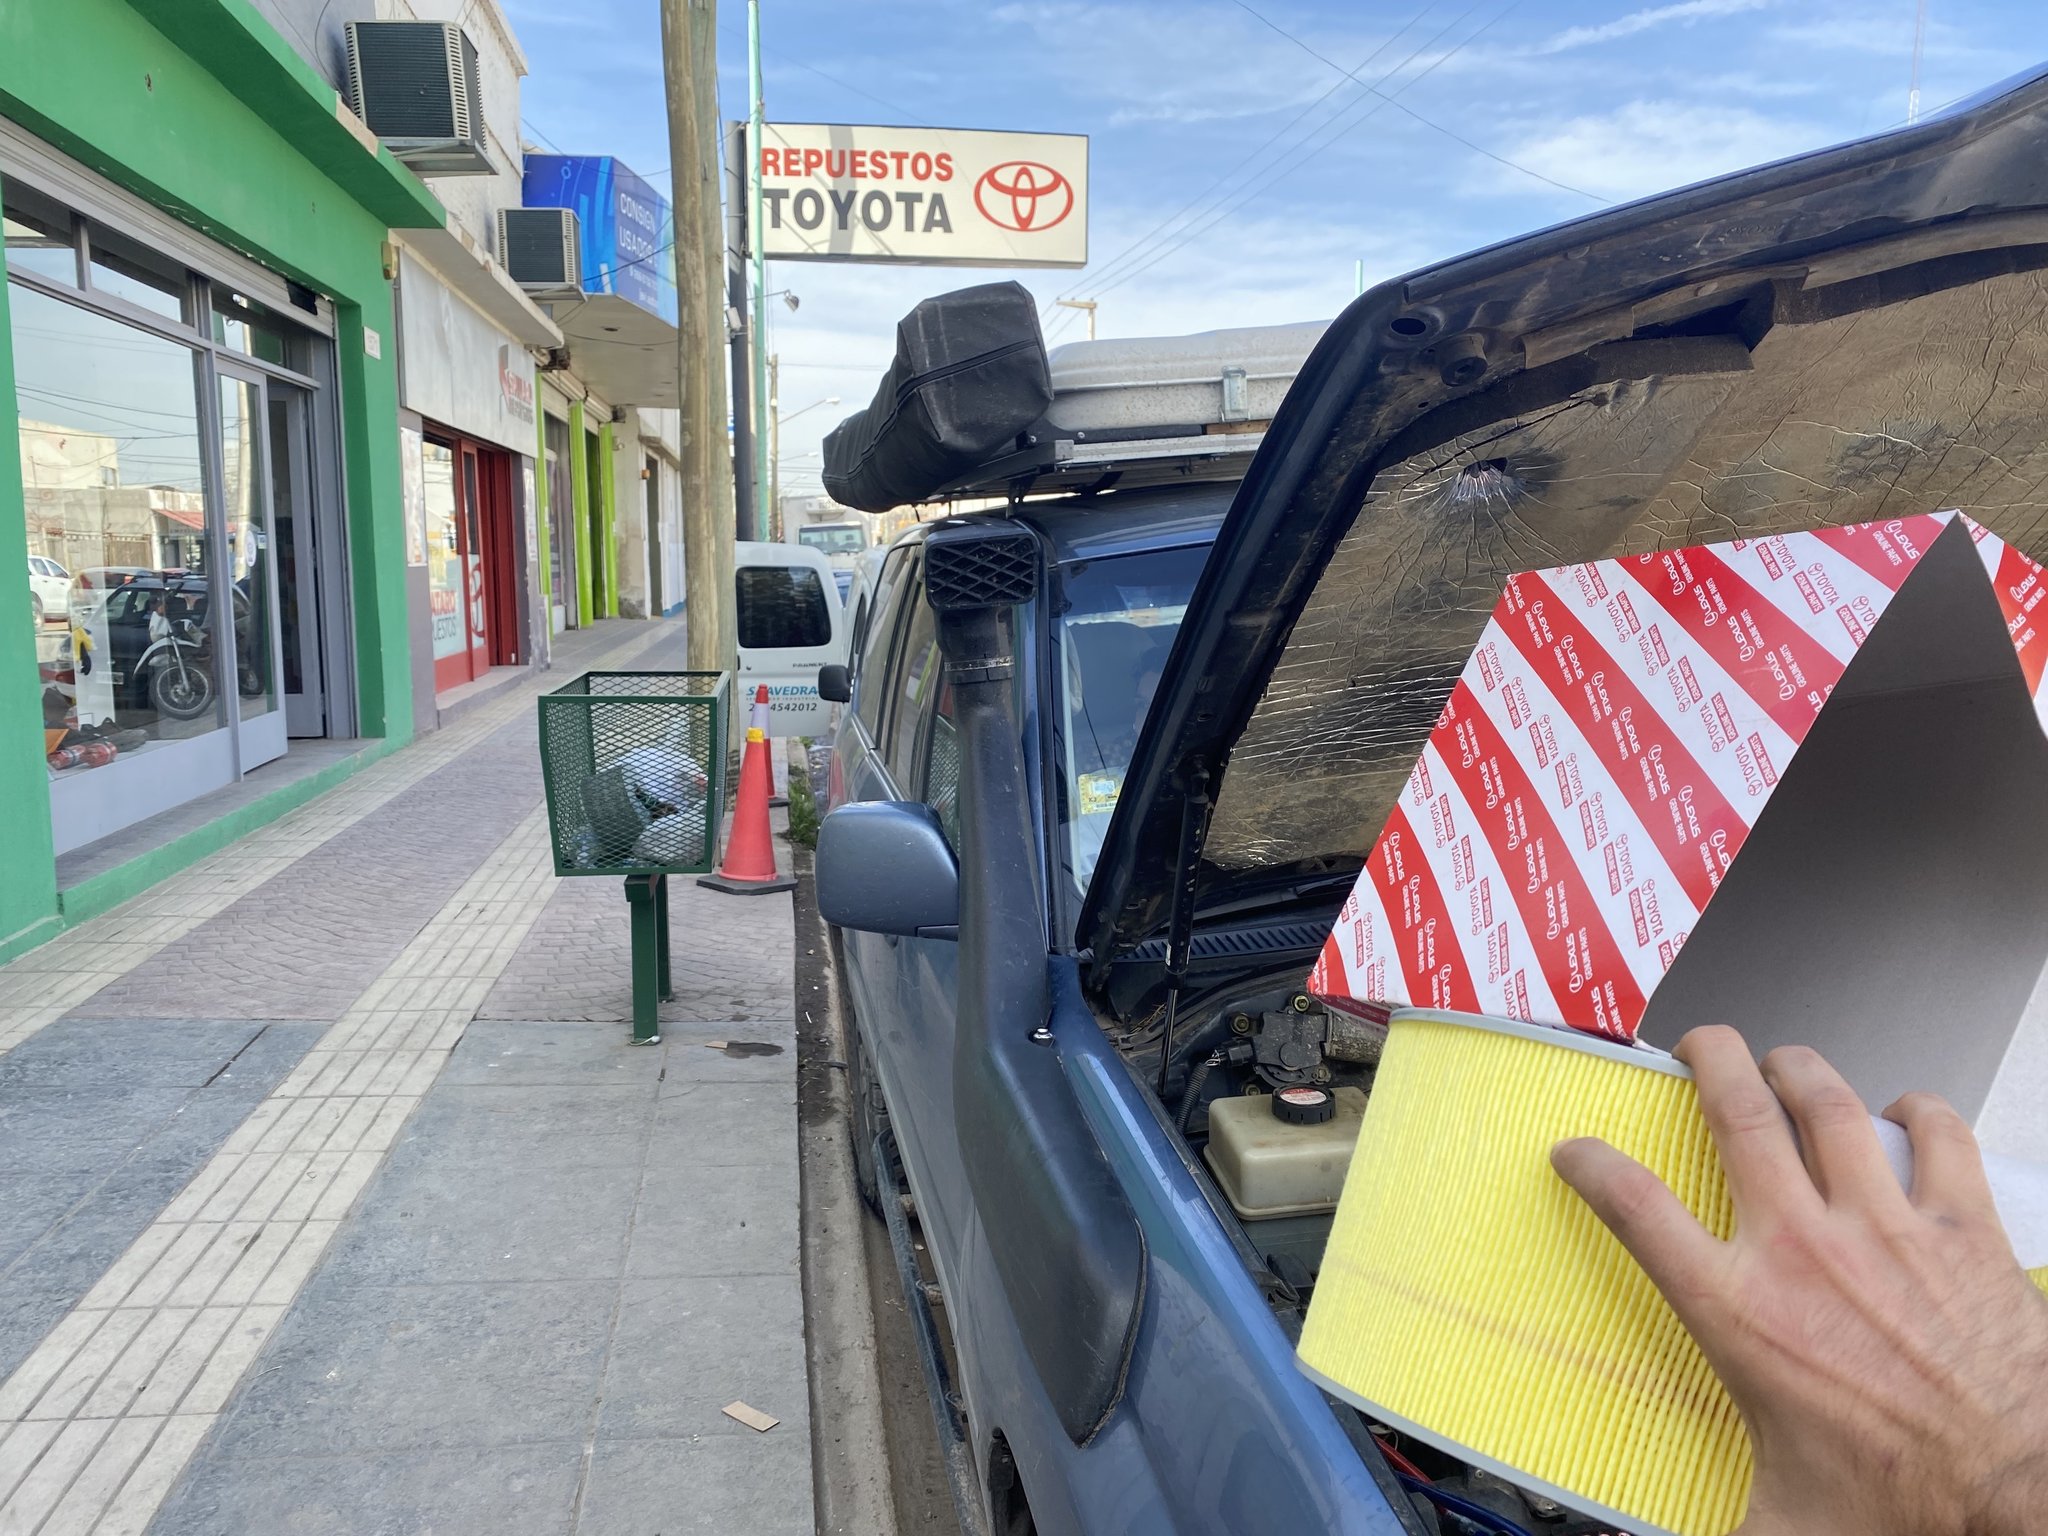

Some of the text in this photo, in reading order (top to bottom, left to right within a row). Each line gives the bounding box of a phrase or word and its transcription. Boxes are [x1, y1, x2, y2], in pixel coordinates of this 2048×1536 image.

[761, 148, 953, 181] REPUESTOS
[762, 188, 953, 233] TOYOTA
[1776, 543, 1795, 571] TOYOTA
[1894, 530, 1919, 558] LEXUS
[1574, 567, 1591, 595] TOYOTA
[1662, 555, 1679, 584] LEXUS
[1510, 580, 1524, 608] LEXUS
[1693, 585, 1711, 614] LEXUS
[1815, 572, 1838, 605] TOYOTA
[1537, 611, 1552, 642] LEXUS
[1606, 600, 1623, 631] TOYOTA
[1727, 616, 1746, 648] LEXUS
[1860, 608, 1877, 626] TOY
[1638, 634, 1653, 665] TOYOTA
[1854, 630, 1865, 643] PAR
[1490, 652, 1504, 683] TOYOTA
[1567, 646, 1583, 679] LEXUS
[1765, 652, 1786, 686] LEXUS
[746, 686, 818, 696] SAVEDRA
[1597, 683, 1612, 715] LEXUS
[1667, 667, 1684, 700] TOYOTA
[1516, 688, 1531, 720] TOYOTA
[1624, 719, 1640, 753] LEXUS
[1700, 703, 1718, 739] TOYOTA
[1455, 723, 1468, 755] LEXUS
[1544, 726, 1558, 759] TOYOTA
[1479, 762, 1492, 795] LEXUS
[1654, 758, 1669, 794] LEXUS
[1735, 744, 1755, 781] TOYOTA
[1407, 770, 1419, 793] TOYO
[1569, 764, 1583, 799] TOYOTA
[1430, 801, 1441, 835] TOYOTA
[1504, 803, 1515, 837] LEXUS
[1594, 805, 1608, 840] TOYOTA
[1684, 799, 1700, 837] LEXUS
[1393, 844, 1404, 879] LEXUS
[1451, 844, 1461, 878] TOYOTA
[1525, 843, 1535, 879] LEXUS
[1620, 847, 1633, 885] TOYOTA
[1700, 842, 1714, 871] GENUINE
[1717, 845, 1731, 872] LEX
[1412, 889, 1421, 923] LEXUS
[1469, 886, 1479, 921] TOYOTA
[1545, 887, 1555, 924] LEXUS
[1647, 893, 1662, 937] TOYOTA
[1487, 930, 1496, 968] TOYOTA
[1566, 933, 1577, 975] LEXUS
[1604, 981, 1615, 1007] PARTS
